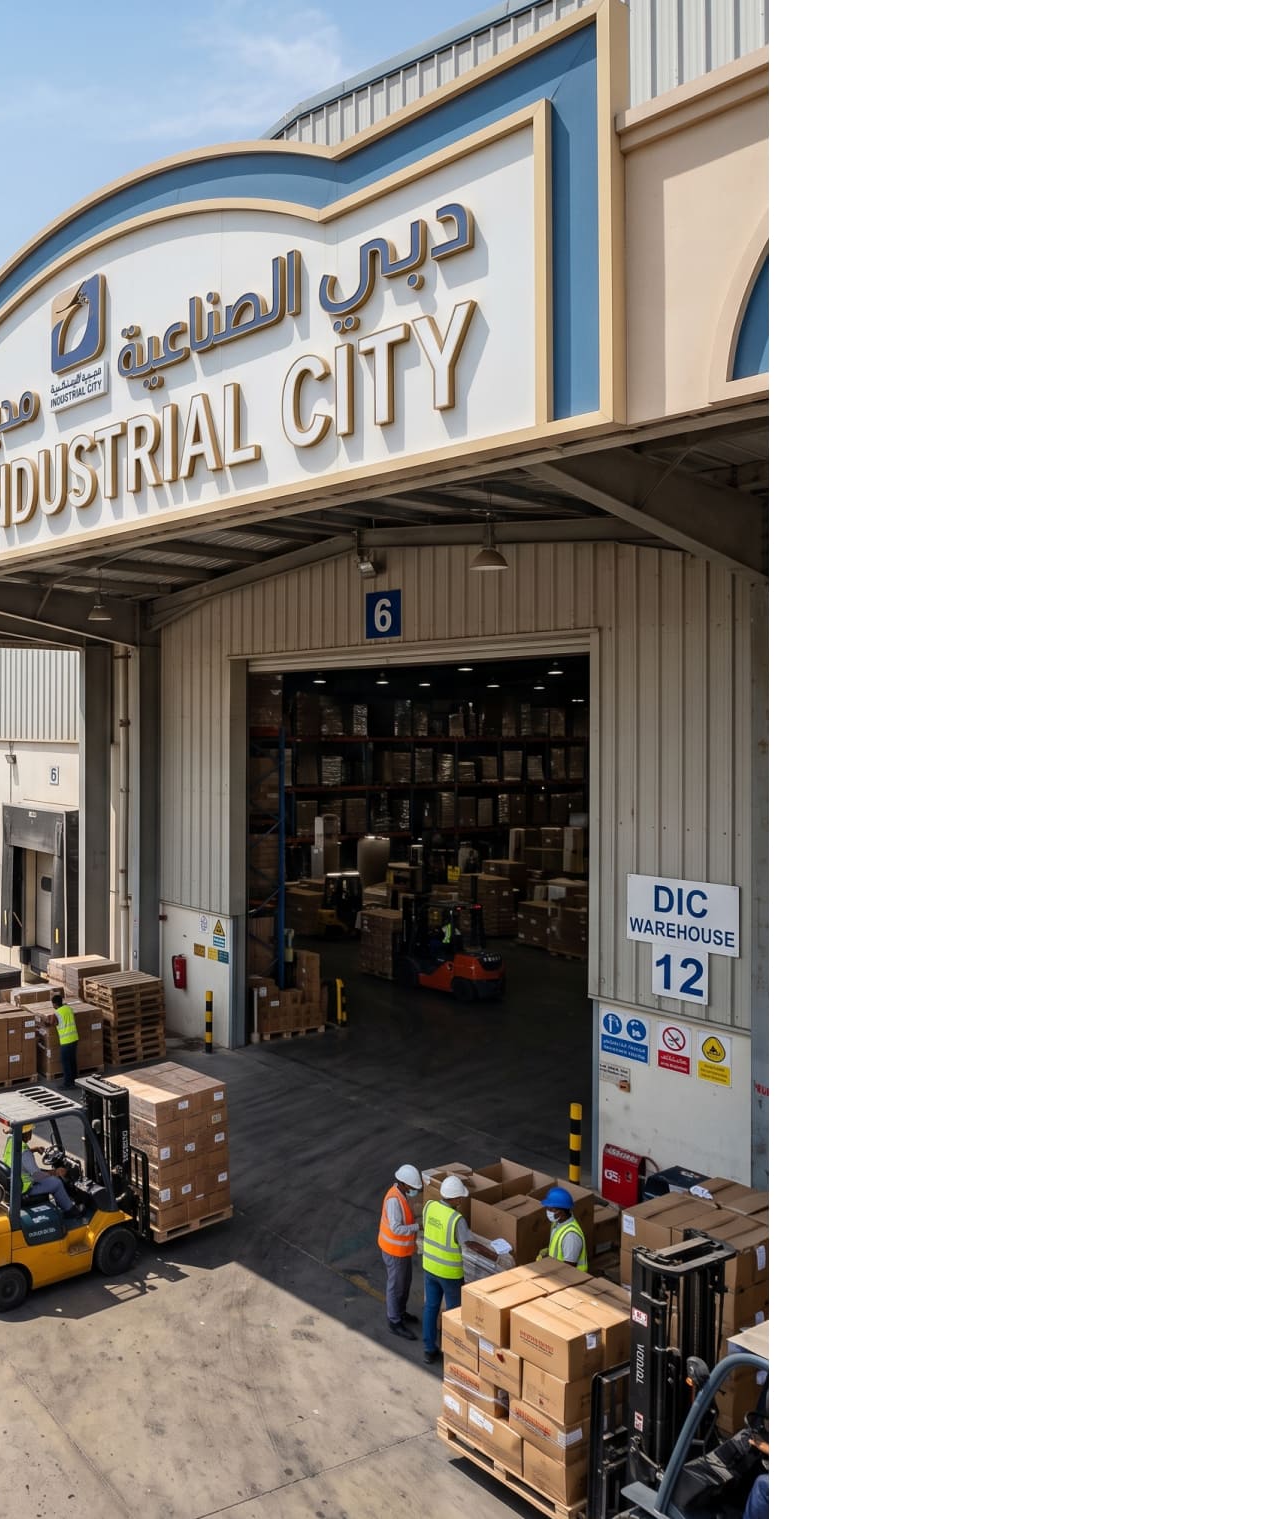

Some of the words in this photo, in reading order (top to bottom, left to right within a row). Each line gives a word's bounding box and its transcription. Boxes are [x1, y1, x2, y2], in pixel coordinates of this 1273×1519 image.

[319, 203, 475, 334] دبي
[117, 249, 302, 390] الصناعية
[281, 299, 478, 448] CITY
[50, 386, 86, 408] INDUSTRIAL
[87, 380, 102, 393] CITY
[374, 598, 392, 632] 6
[51, 767, 57, 781] 6
[654, 884, 708, 918] DIC
[629, 917, 735, 948] WAREHOUSE
[655, 953, 704, 997] 12
